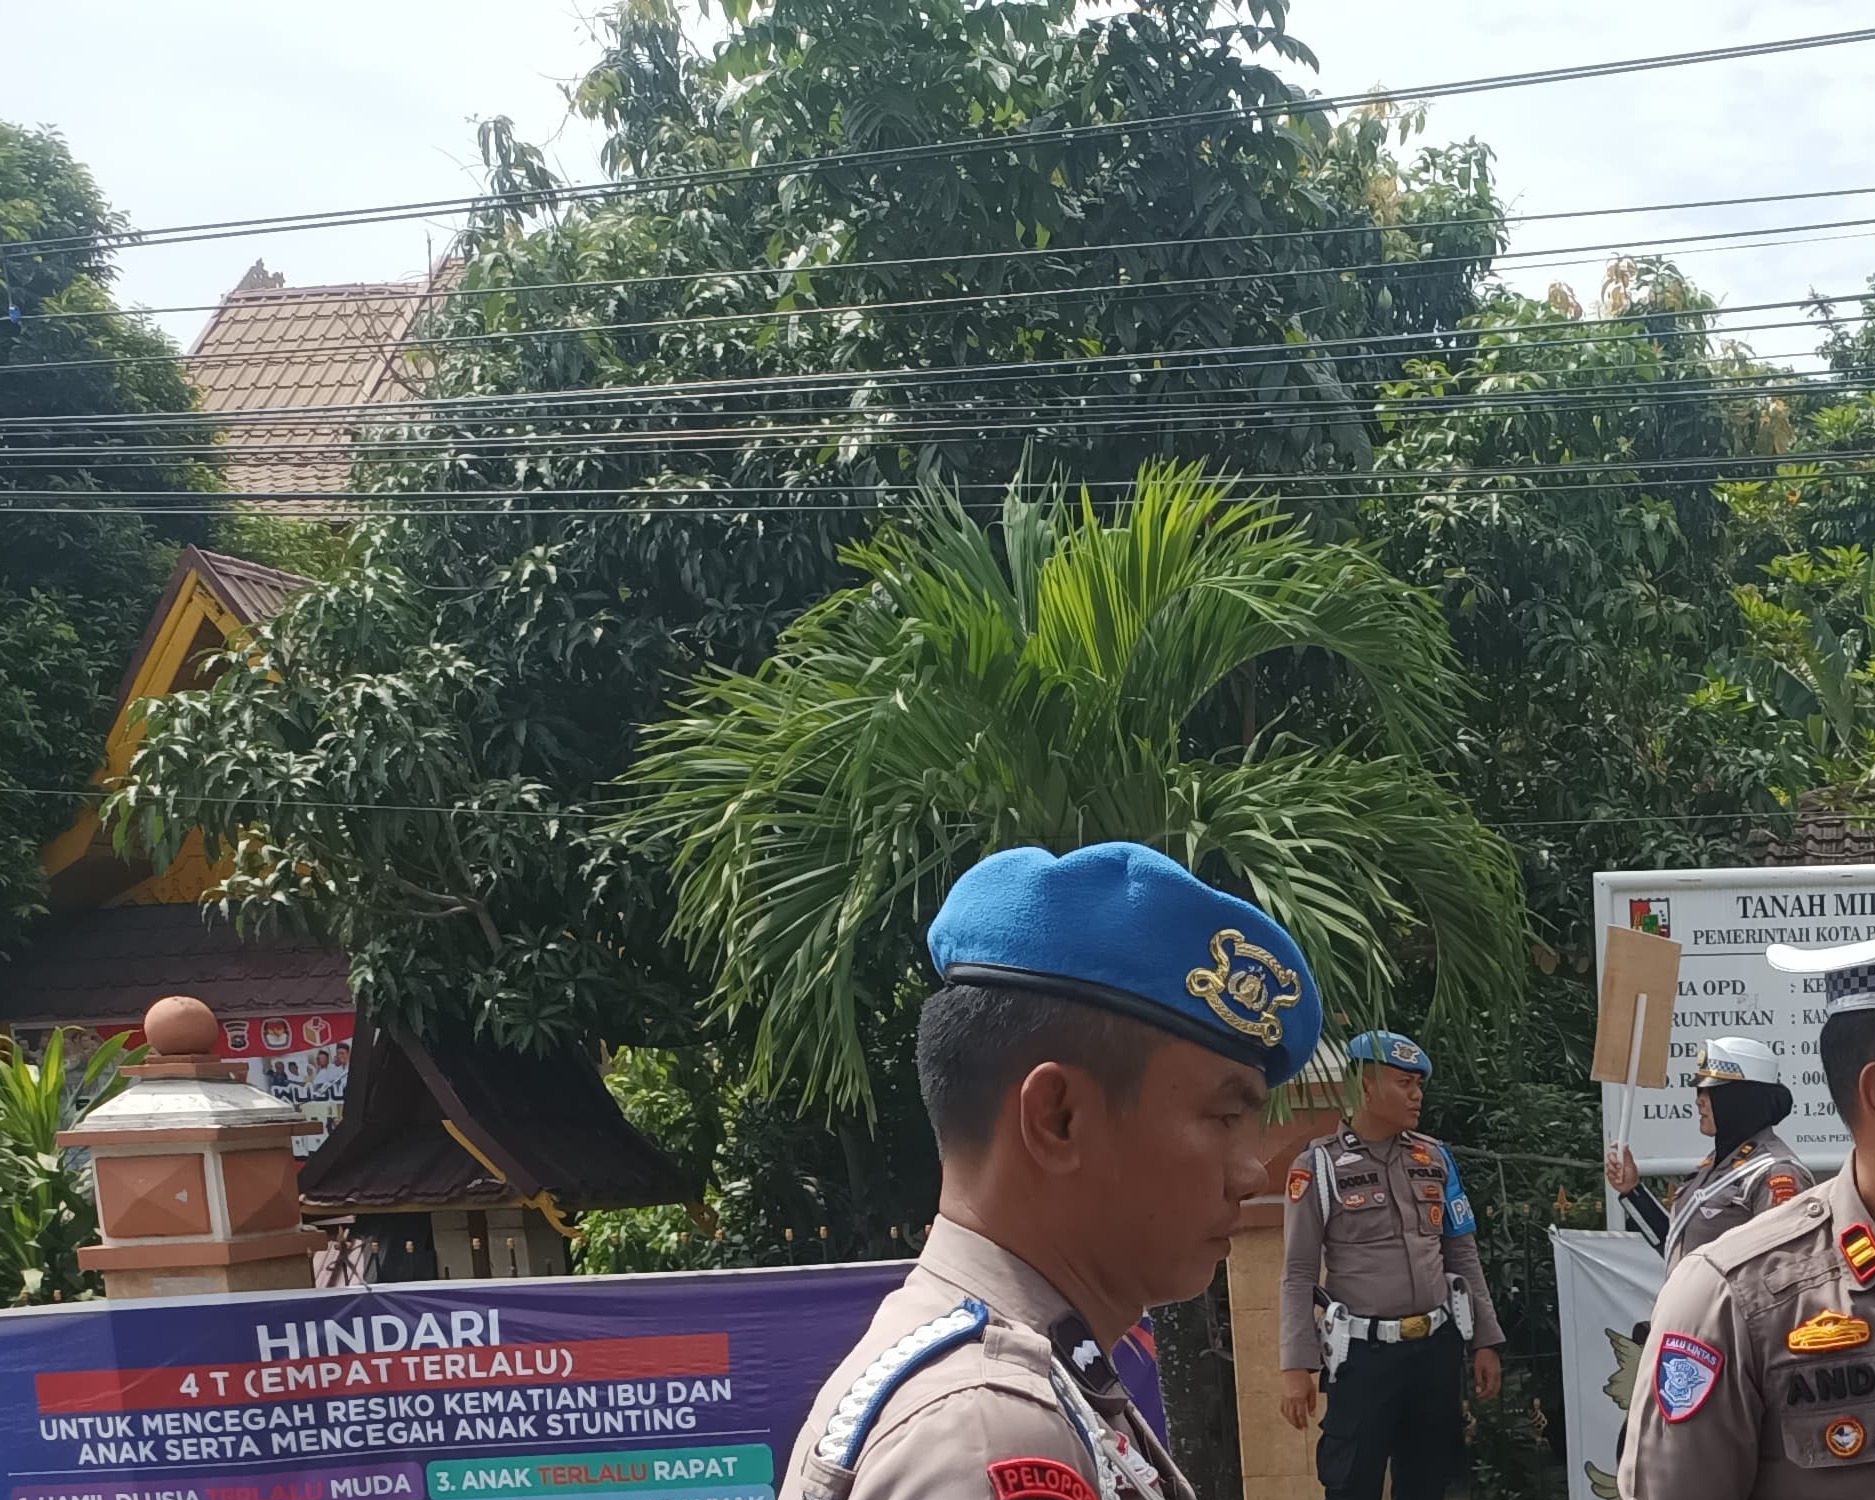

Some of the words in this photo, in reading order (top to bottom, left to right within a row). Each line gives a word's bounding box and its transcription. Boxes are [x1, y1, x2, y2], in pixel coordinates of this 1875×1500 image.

[1737, 894, 1827, 919] TANAH
[1693, 926, 1810, 946] PEMERINTAH
[1816, 926, 1862, 943] KOTA
[1702, 979, 1746, 997] OPD
[1643, 1104, 1693, 1121] LUAS
[1796, 1133, 1827, 1143] DINAS
[256, 1309, 500, 1362] HINDARI
[179, 1372, 199, 1398] 4
[209, 1371, 230, 1397] T
[244, 1358, 393, 1398] (EMPAT
[402, 1348, 573, 1382] TERLALU)
[40, 1414, 135, 1441] UNTUK
[142, 1404, 315, 1437] MENCEGAH
[328, 1394, 434, 1424] RESIKO
[444, 1385, 597, 1416] KEMATIAN
[608, 1382, 656, 1407] IBU
[667, 1379, 733, 1403] DAN
[78, 1442, 158, 1466] ANAK
[165, 1435, 261, 1461] SERTA
[272, 1421, 444, 1454] MENCEGAH
[454, 1415, 538, 1441] ANAK
[546, 1406, 697, 1436] STUNTING
[330, 1473, 412, 1500] MUDA
[436, 1470, 457, 1493] 3.
[461, 1466, 532, 1491] ANAK
[538, 1462, 648, 1486] TERLALU
[654, 1456, 739, 1481] RAPAT
